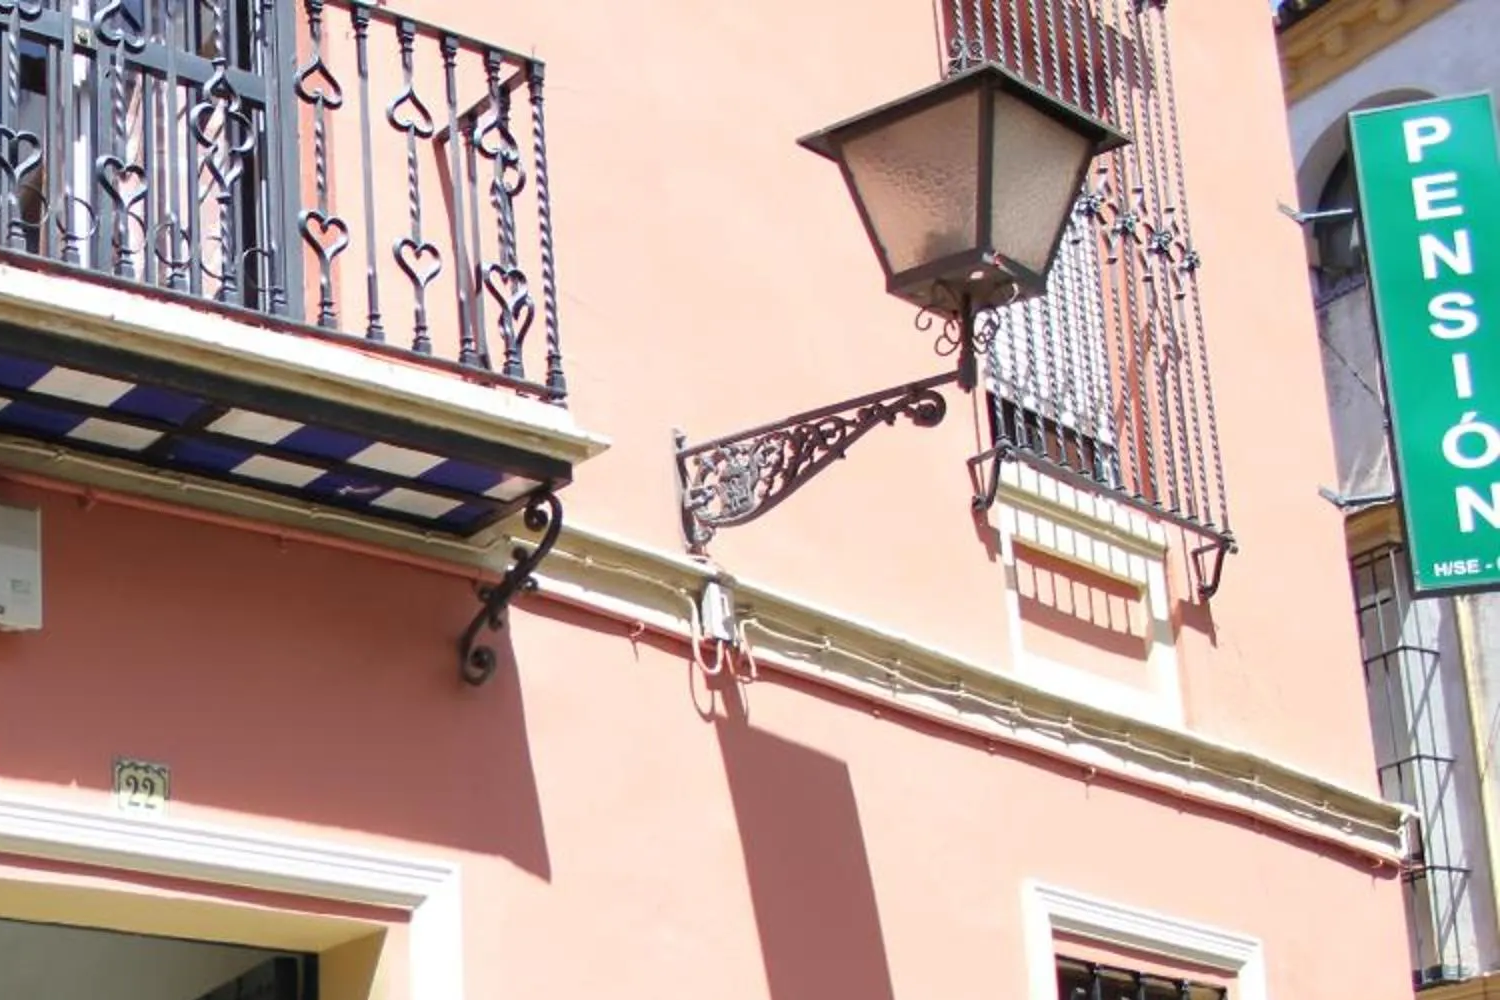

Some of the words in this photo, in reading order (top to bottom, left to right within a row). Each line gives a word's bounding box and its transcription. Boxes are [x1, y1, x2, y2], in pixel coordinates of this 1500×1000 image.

[1402, 114, 1500, 534] PENSIÓN
[1433, 558, 1481, 577] H/SE
[125, 774, 157, 809] 22
